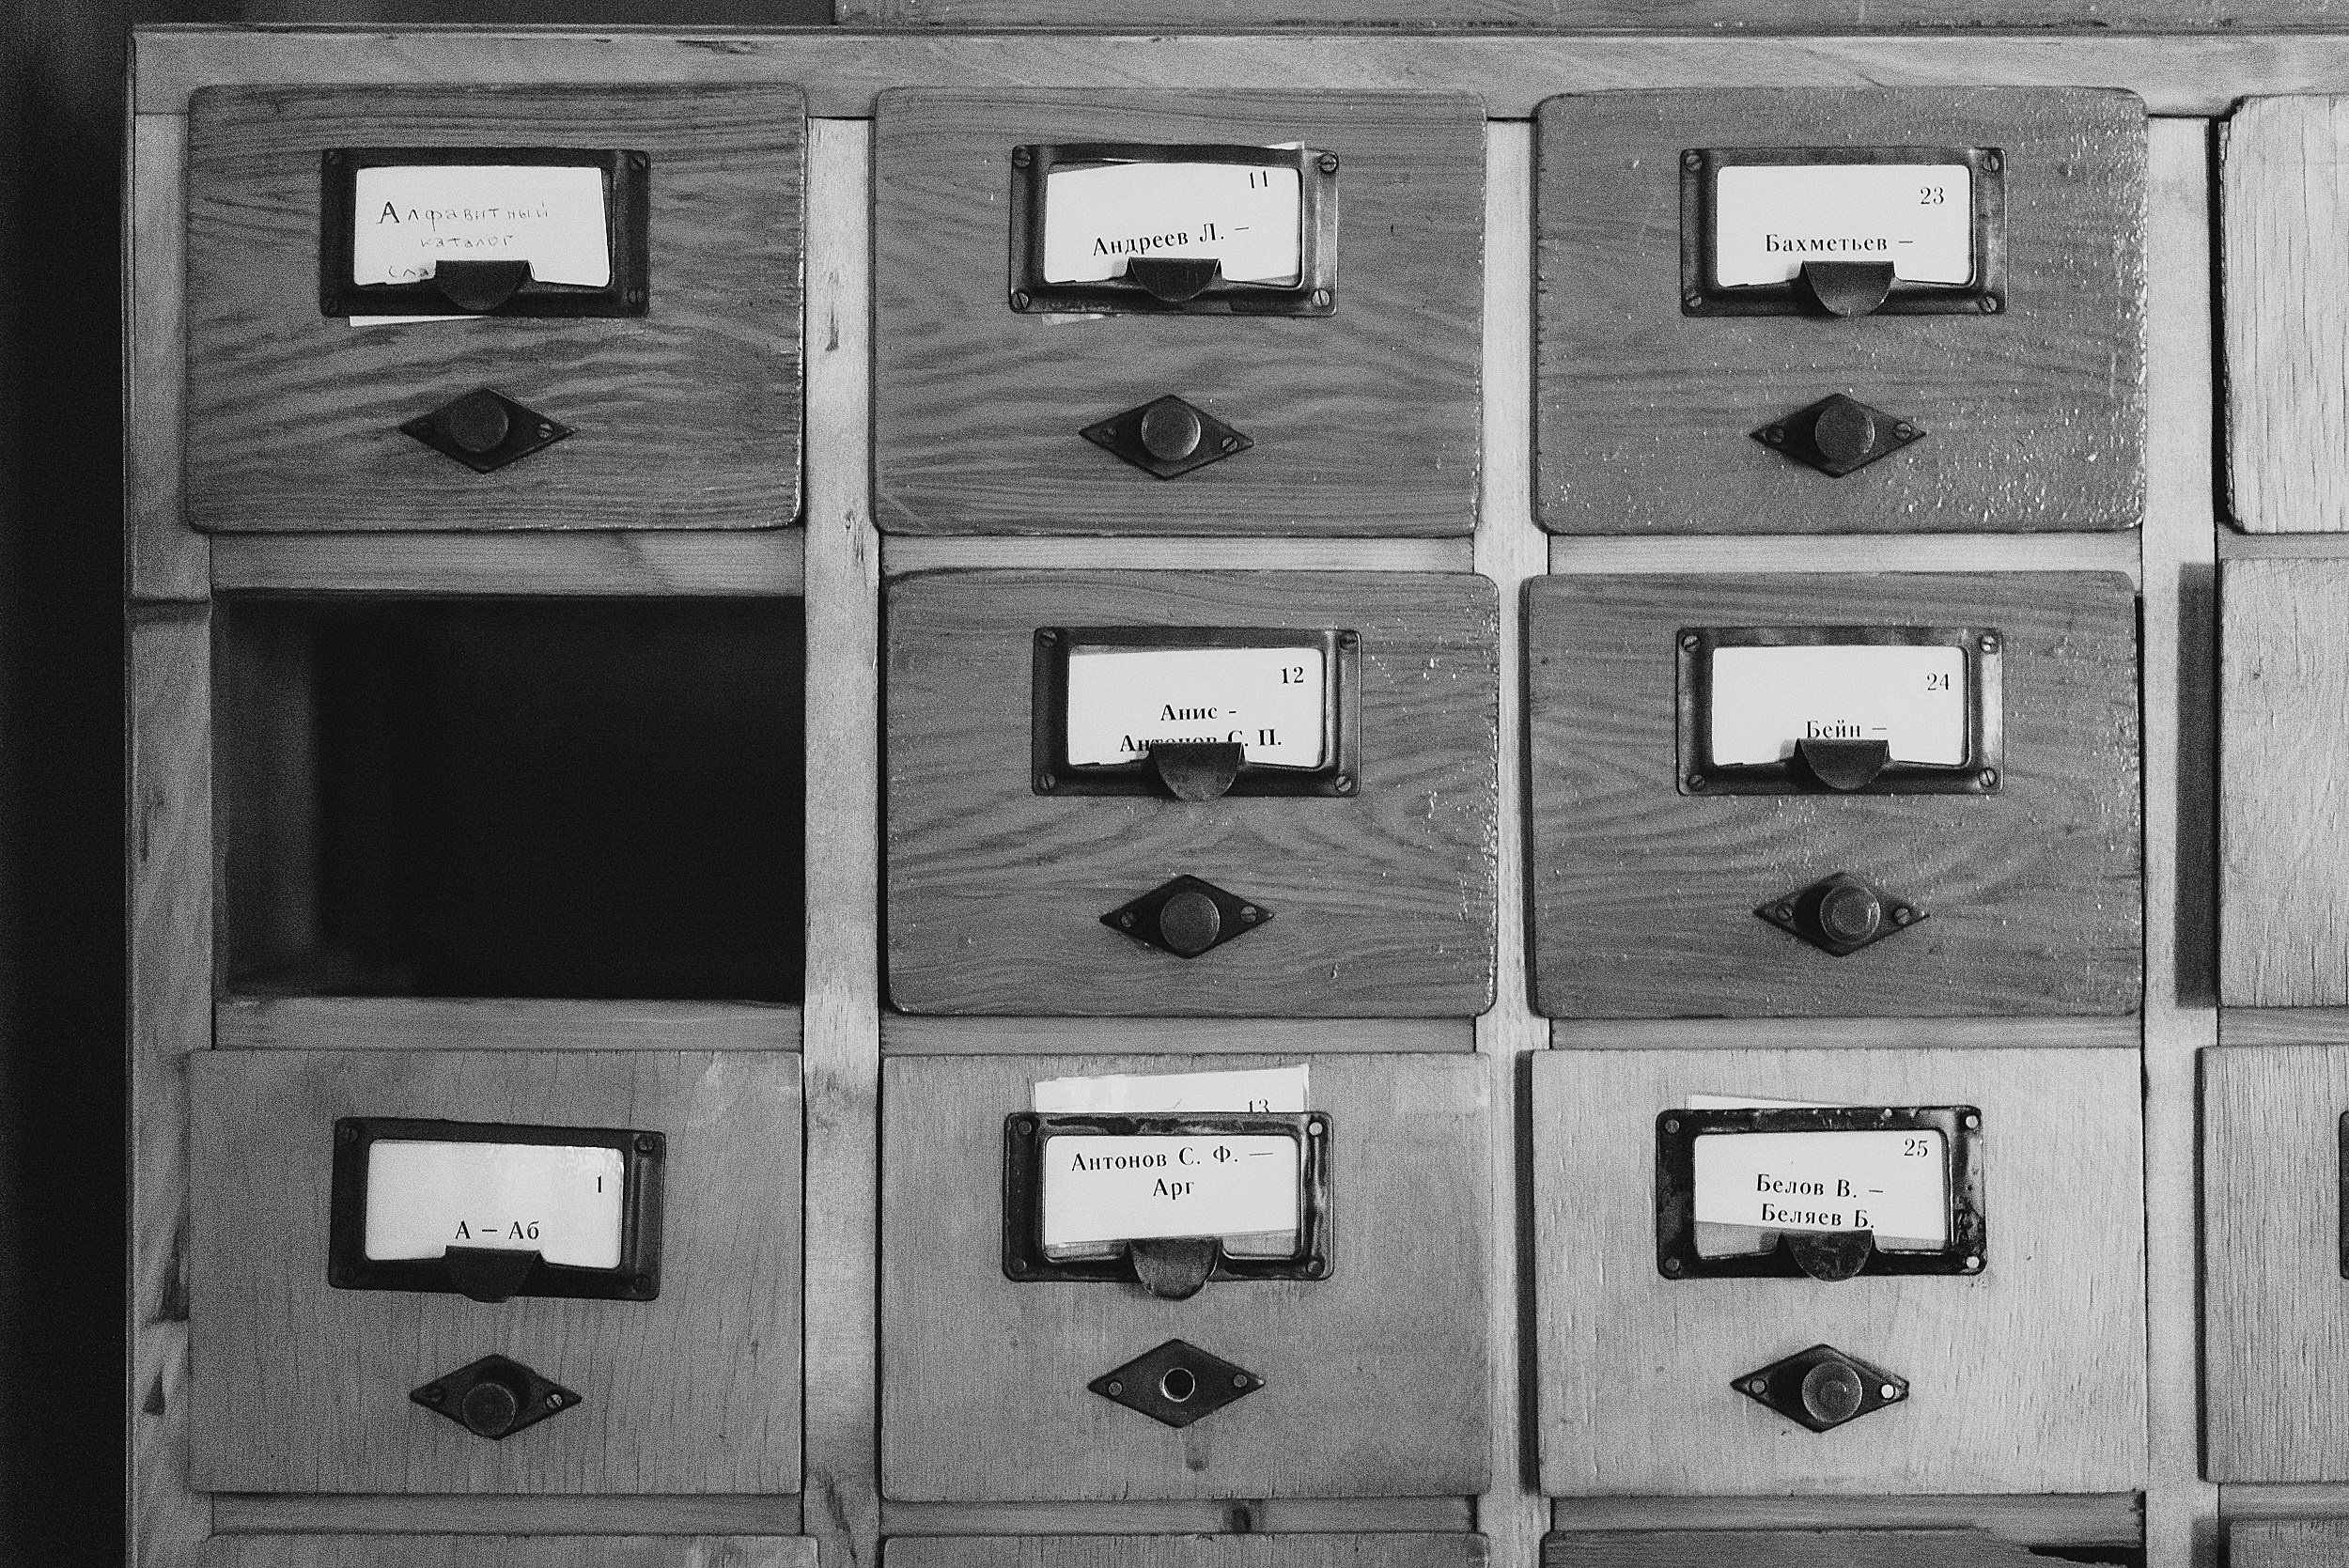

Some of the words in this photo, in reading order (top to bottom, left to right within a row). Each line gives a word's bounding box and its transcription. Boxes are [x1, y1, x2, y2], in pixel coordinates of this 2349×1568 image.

[1249, 169, 1268, 190] 11
[1920, 187, 1945, 206] 23
[376, 200, 549, 233] Алфавитный
[420, 234, 514, 249] каталог
[1093, 231, 1189, 256] Андреев
[1199, 223, 1224, 243] Л.
[1766, 233, 1888, 253] Бахметьев
[1281, 666, 1304, 685] 12
[1926, 673, 1950, 691] 24
[1159, 704, 1218, 722] Анис
[1258, 728, 1283, 747] П.
[1806, 719, 1861, 739] Бейн
[1071, 1152, 1168, 1172] Антонов
[1178, 1147, 1201, 1166] С.
[1212, 1144, 1238, 1164] Ф.
[1904, 1139, 1929, 1157] 25
[597, 1174, 602, 1194] 1
[1152, 1177, 1195, 1201] Арг
[1756, 1172, 1825, 1196] Белов
[1836, 1178, 1858, 1199] В.
[1760, 1203, 1843, 1227] Беляев
[1854, 1209, 1875, 1230] Б.
[454, 1219, 472, 1241] А
[507, 1220, 540, 1241] Аб
